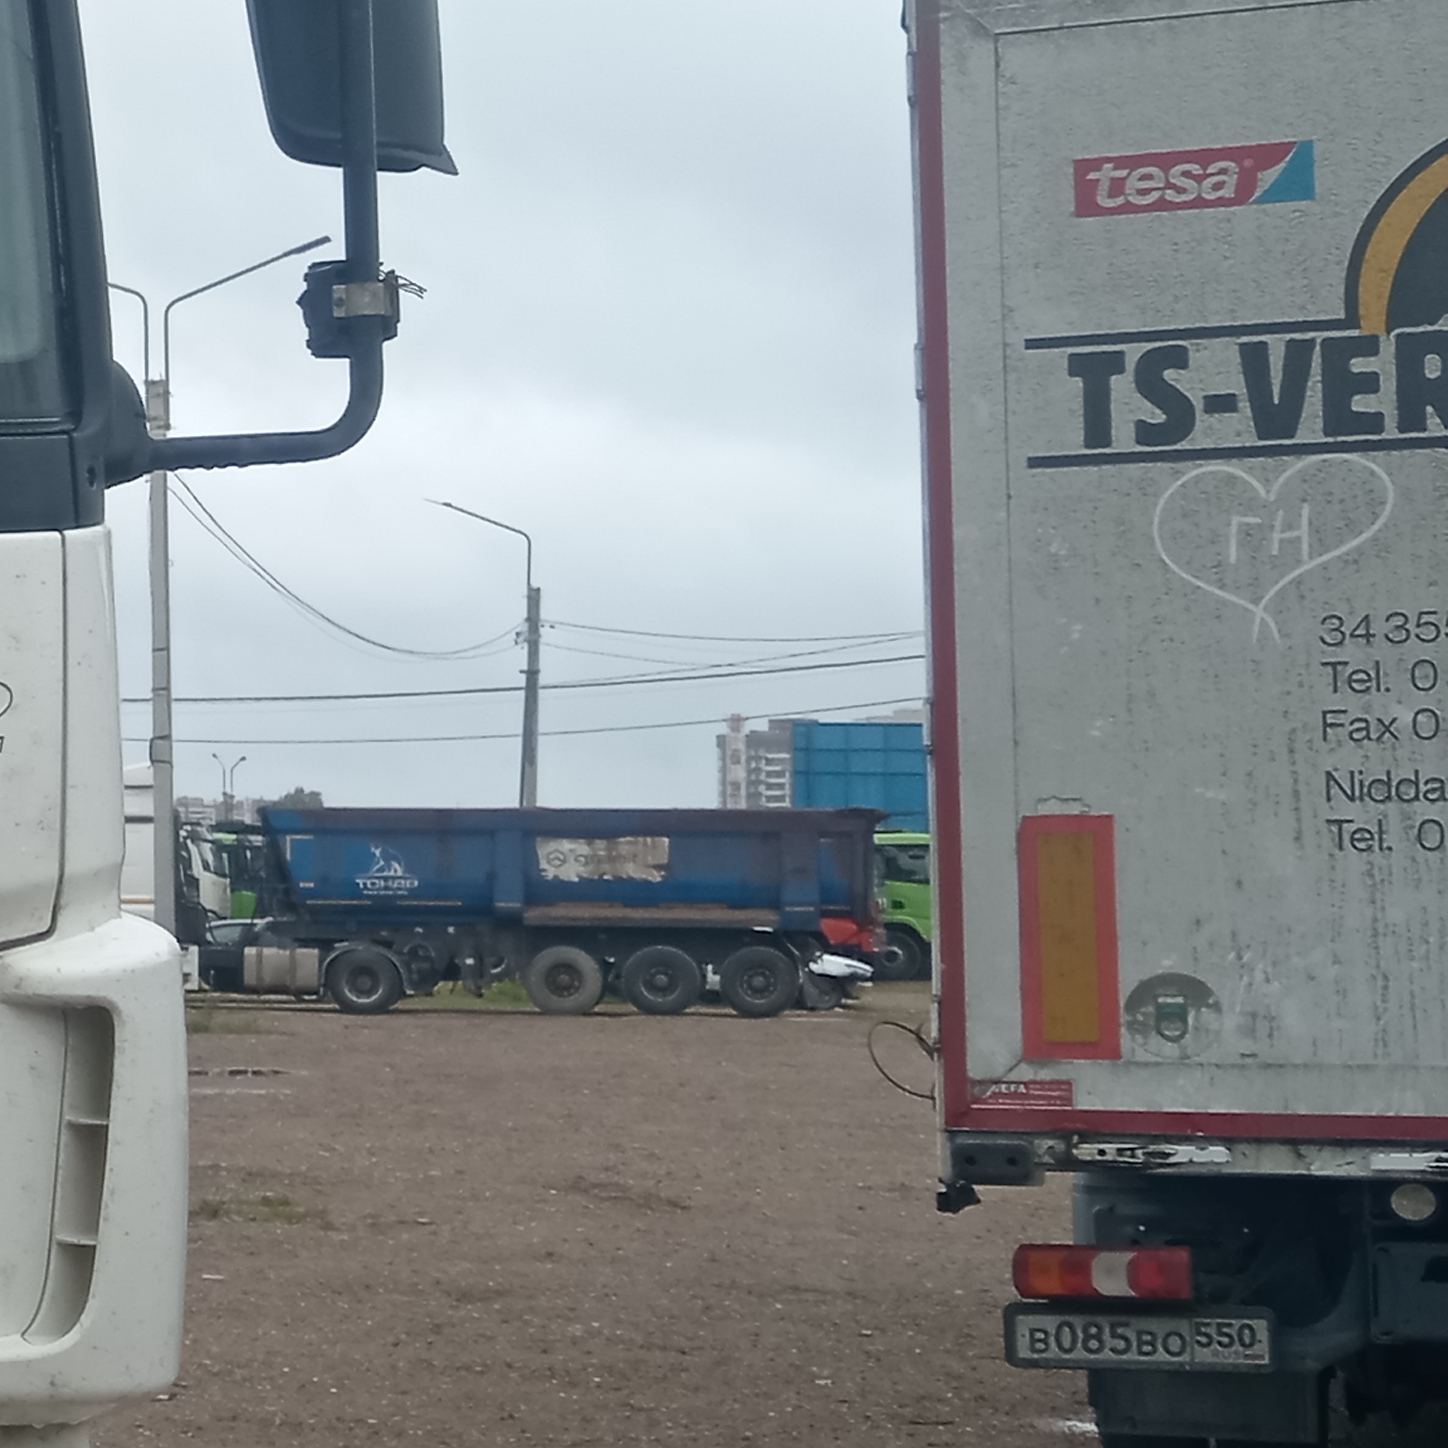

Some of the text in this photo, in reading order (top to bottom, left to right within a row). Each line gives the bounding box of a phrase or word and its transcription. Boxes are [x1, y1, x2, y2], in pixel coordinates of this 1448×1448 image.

[1086, 158, 1238, 208] tesa
[1320, 659, 1391, 694] Tel.
[1321, 709, 1400, 742] Fax
[1324, 769, 1448, 803] Nidda
[1325, 818, 1394, 852] Tel.
